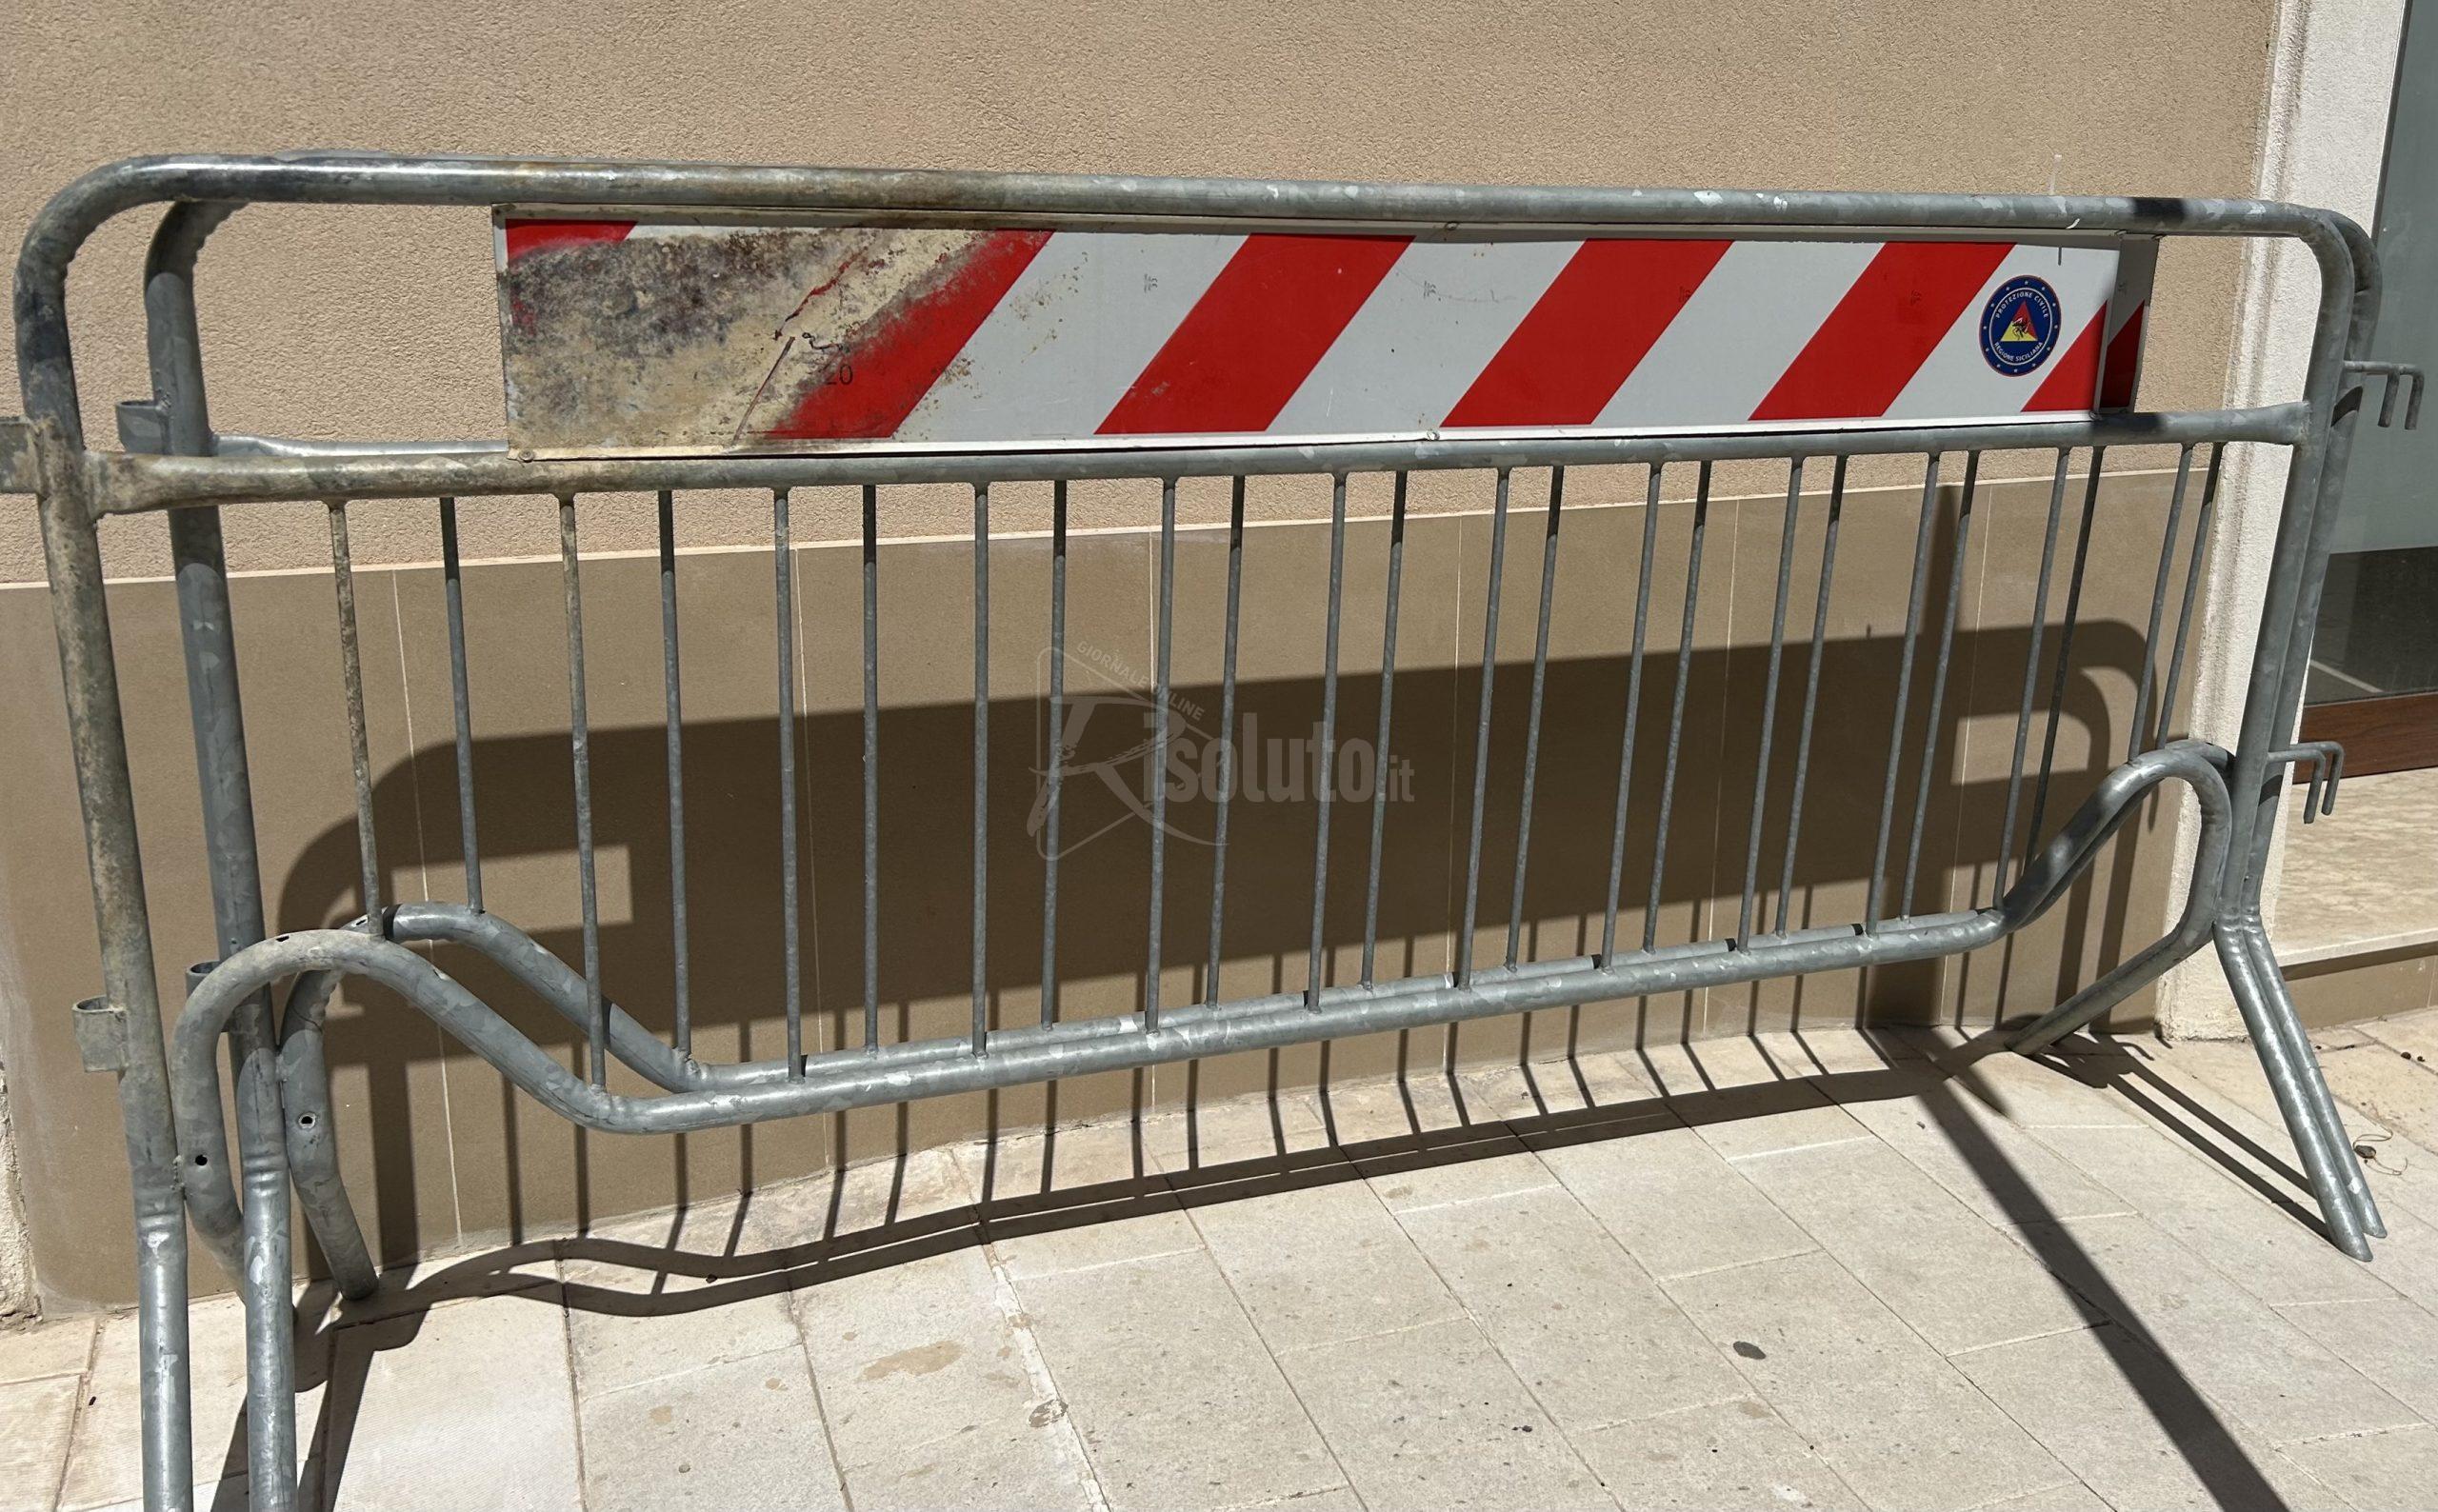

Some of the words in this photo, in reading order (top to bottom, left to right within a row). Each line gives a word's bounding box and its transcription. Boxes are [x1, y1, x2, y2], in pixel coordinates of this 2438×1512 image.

[1995, 291, 2033, 319] PROTEZIONE
[2033, 295, 2048, 318] CIVILE
[1994, 342, 2014, 361] REGIONE
[2015, 342, 2043, 362] SICILIANA
